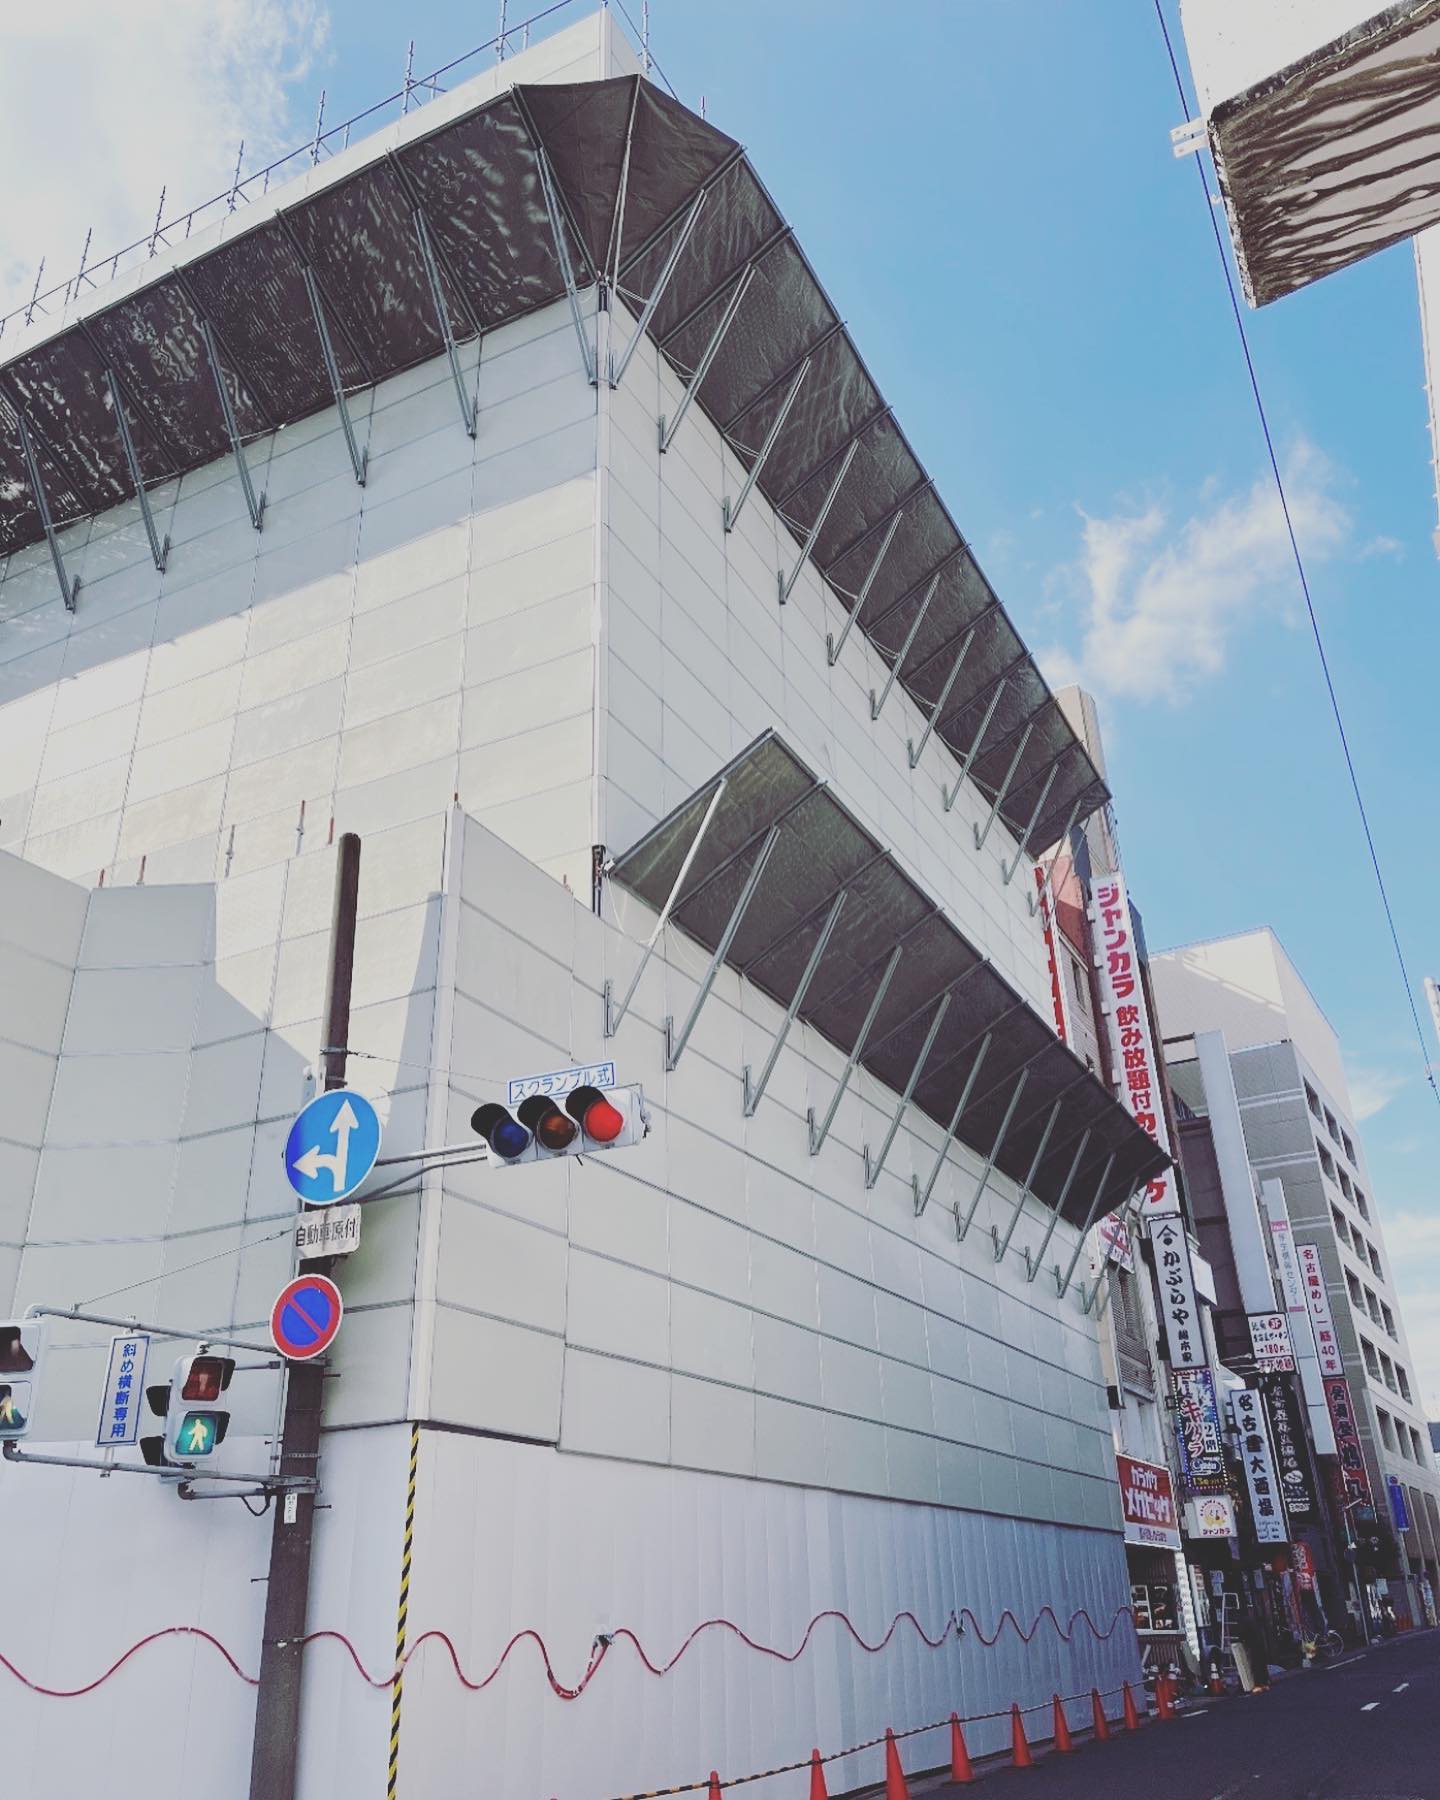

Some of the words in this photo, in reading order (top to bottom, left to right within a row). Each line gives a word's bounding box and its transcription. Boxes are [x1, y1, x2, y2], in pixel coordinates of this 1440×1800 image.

[1097, 883, 1135, 999] ジャンカラ
[514, 1066, 610, 1099] スクランブル式
[295, 1217, 356, 1247] 自動車原付
[1163, 1250, 1190, 1326] かぶらや
[1303, 1249, 1337, 1371] 名古屋めし一筋40年
[111, 1343, 137, 1438] 斜め横断専用
